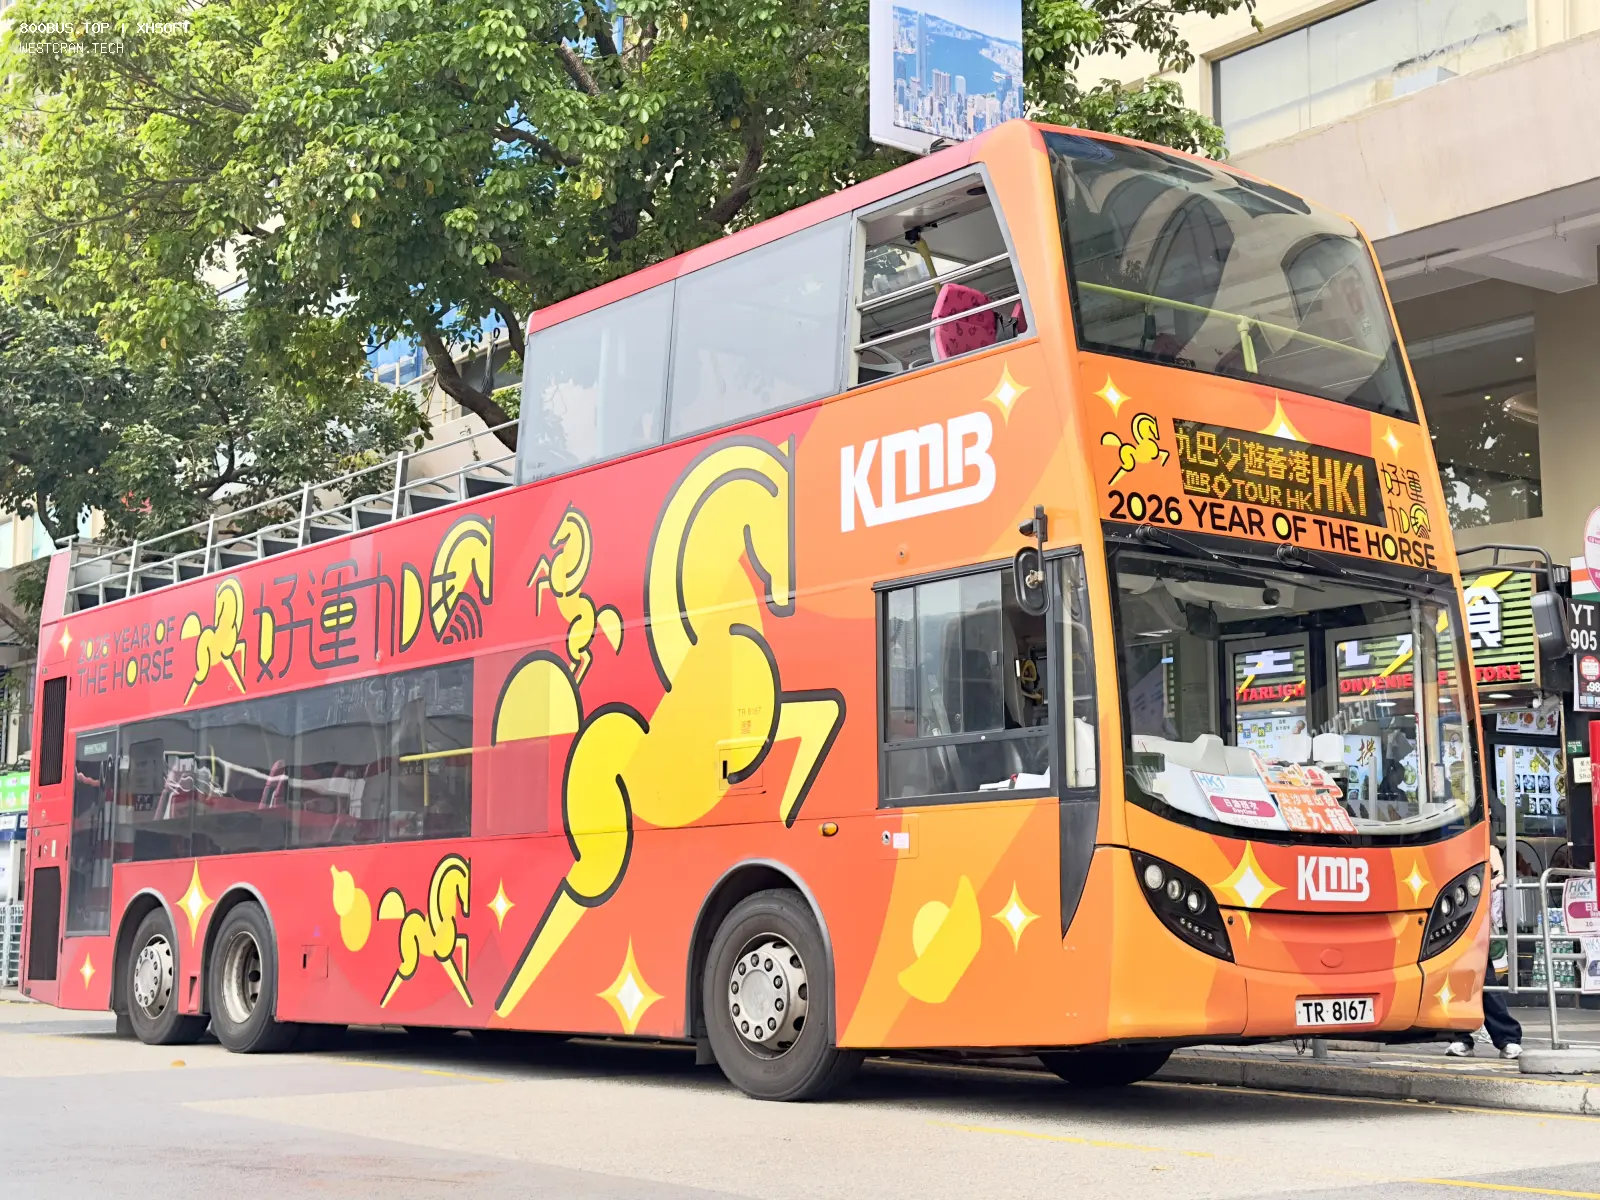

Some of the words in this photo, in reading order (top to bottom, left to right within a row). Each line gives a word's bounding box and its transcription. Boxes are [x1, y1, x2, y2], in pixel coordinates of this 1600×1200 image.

[840, 411, 996, 533] KMB
[1243, 440, 1311, 484] 遊香港
[1182, 469, 1212, 494] MB
[1232, 478, 1283, 507] TOUR
[1286, 488, 1314, 512] HK
[1311, 455, 1368, 517] HK1
[1108, 490, 1183, 526] 2026
[1188, 499, 1266, 536] YEAR
[1271, 511, 1309, 543] OF
[1312, 518, 1362, 554] THE
[1366, 529, 1438, 570] HORSE
[1571, 603, 1595, 626] YT
[77, 633, 110, 664] 2026
[113, 624, 150, 654] YEAR
[154, 616, 176, 645] OF
[1571, 629, 1598, 651] 905
[77, 659, 107, 698] THE
[112, 646, 174, 691] HORSE
[1197, 774, 1225, 789] HK1
[1283, 805, 1355, 832] 遊九龍
[1297, 855, 1371, 902] KMB
[1568, 879, 1594, 893] HK1
[1303, 1002, 1325, 1023] TR
[1332, 999, 1368, 1022] 8167
